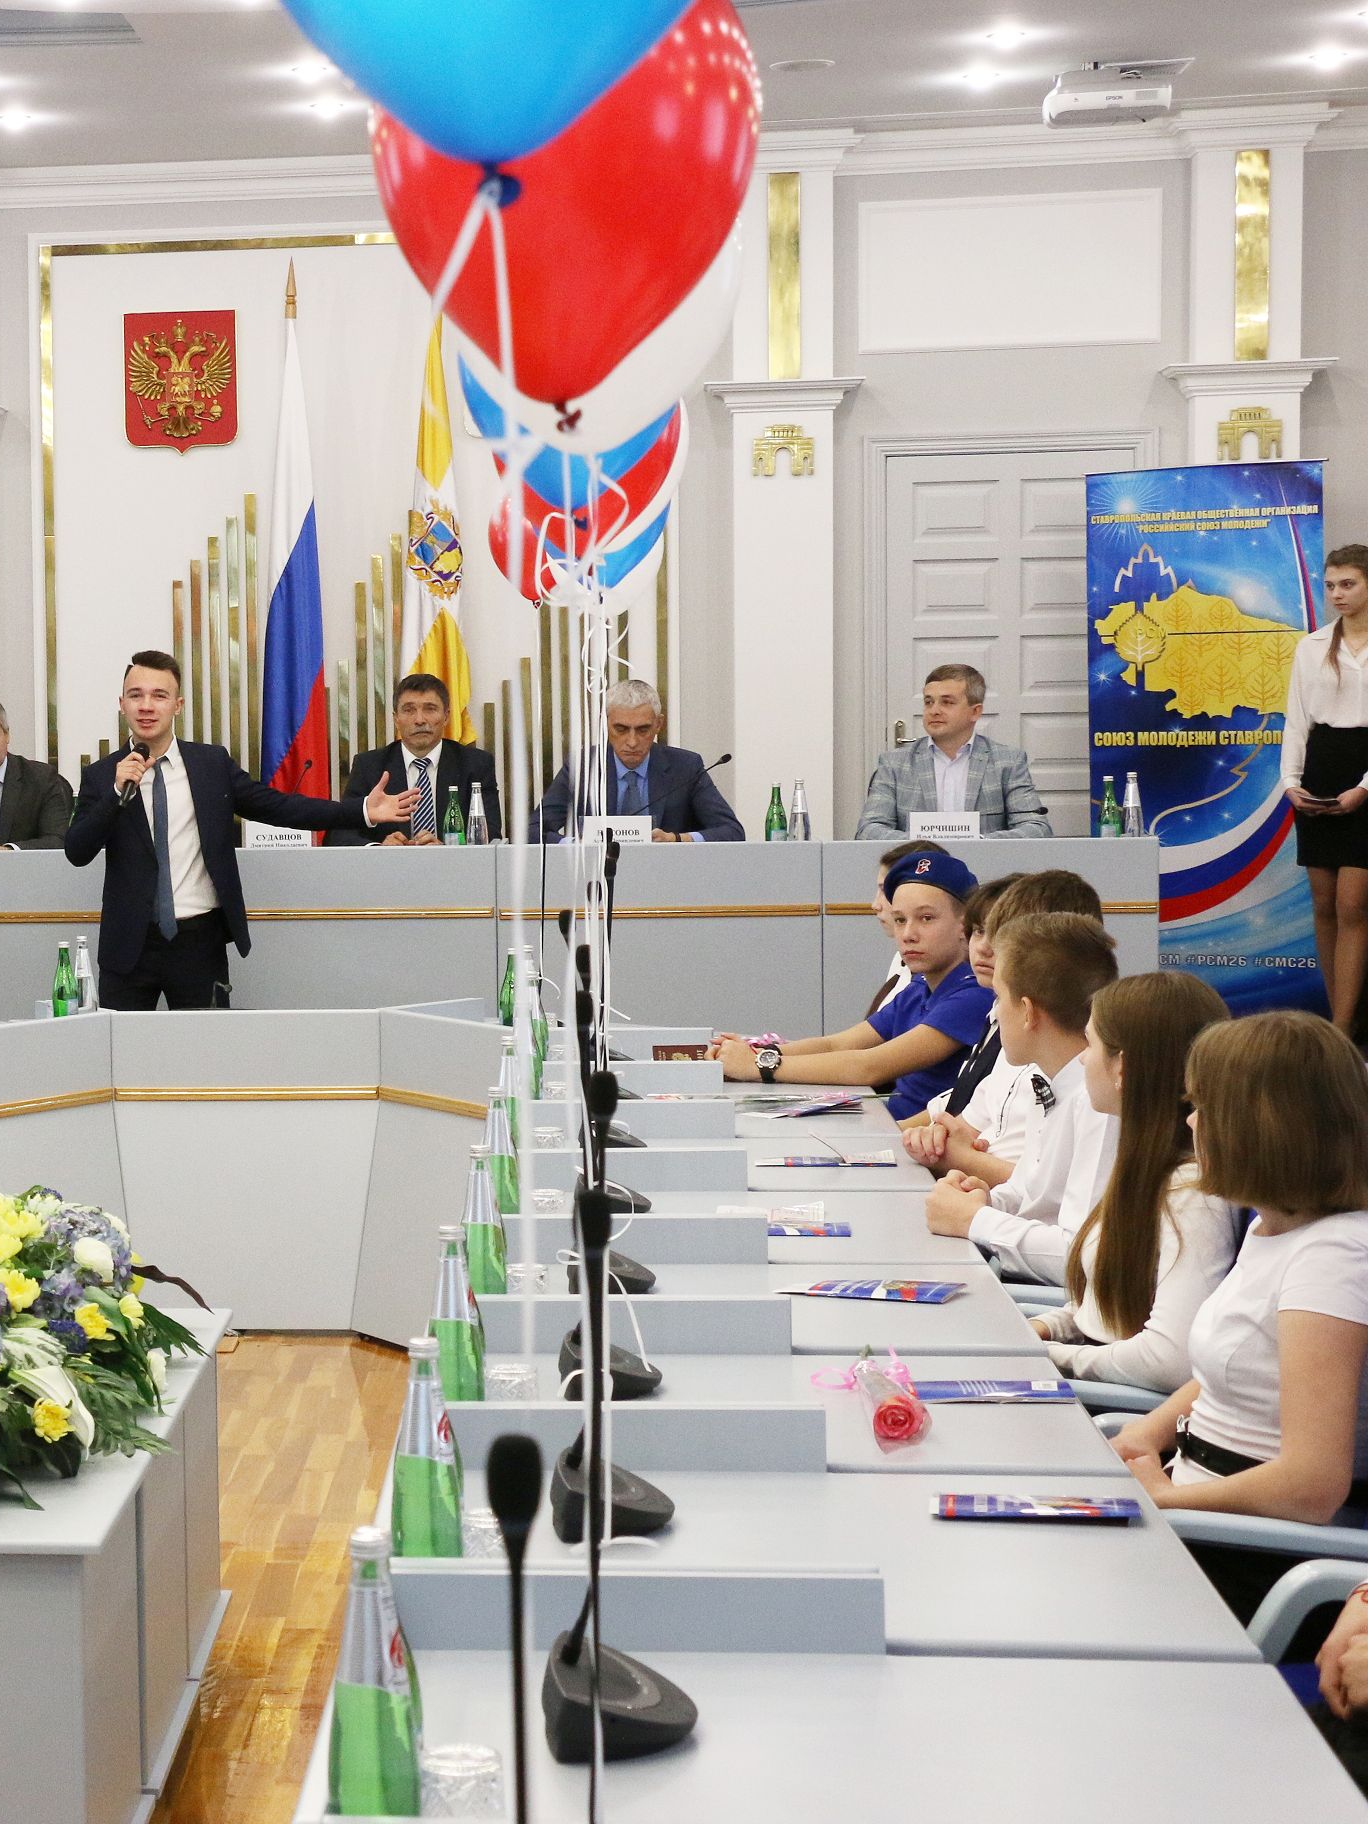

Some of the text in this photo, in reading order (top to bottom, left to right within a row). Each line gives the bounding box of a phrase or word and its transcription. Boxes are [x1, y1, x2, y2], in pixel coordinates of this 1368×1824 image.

[1197, 508, 1260, 519] ОБЩЕСТВЕННАЯ
[1261, 505, 1319, 516] ОРГАНИЗАЦИЯ
[1094, 731, 1135, 746] СОЮЗ
[1138, 730, 1217, 747] МОЛОДЕЖИ
[1185, 954, 1247, 967] #РСМ26
[1254, 956, 1317, 969] #СМС26
